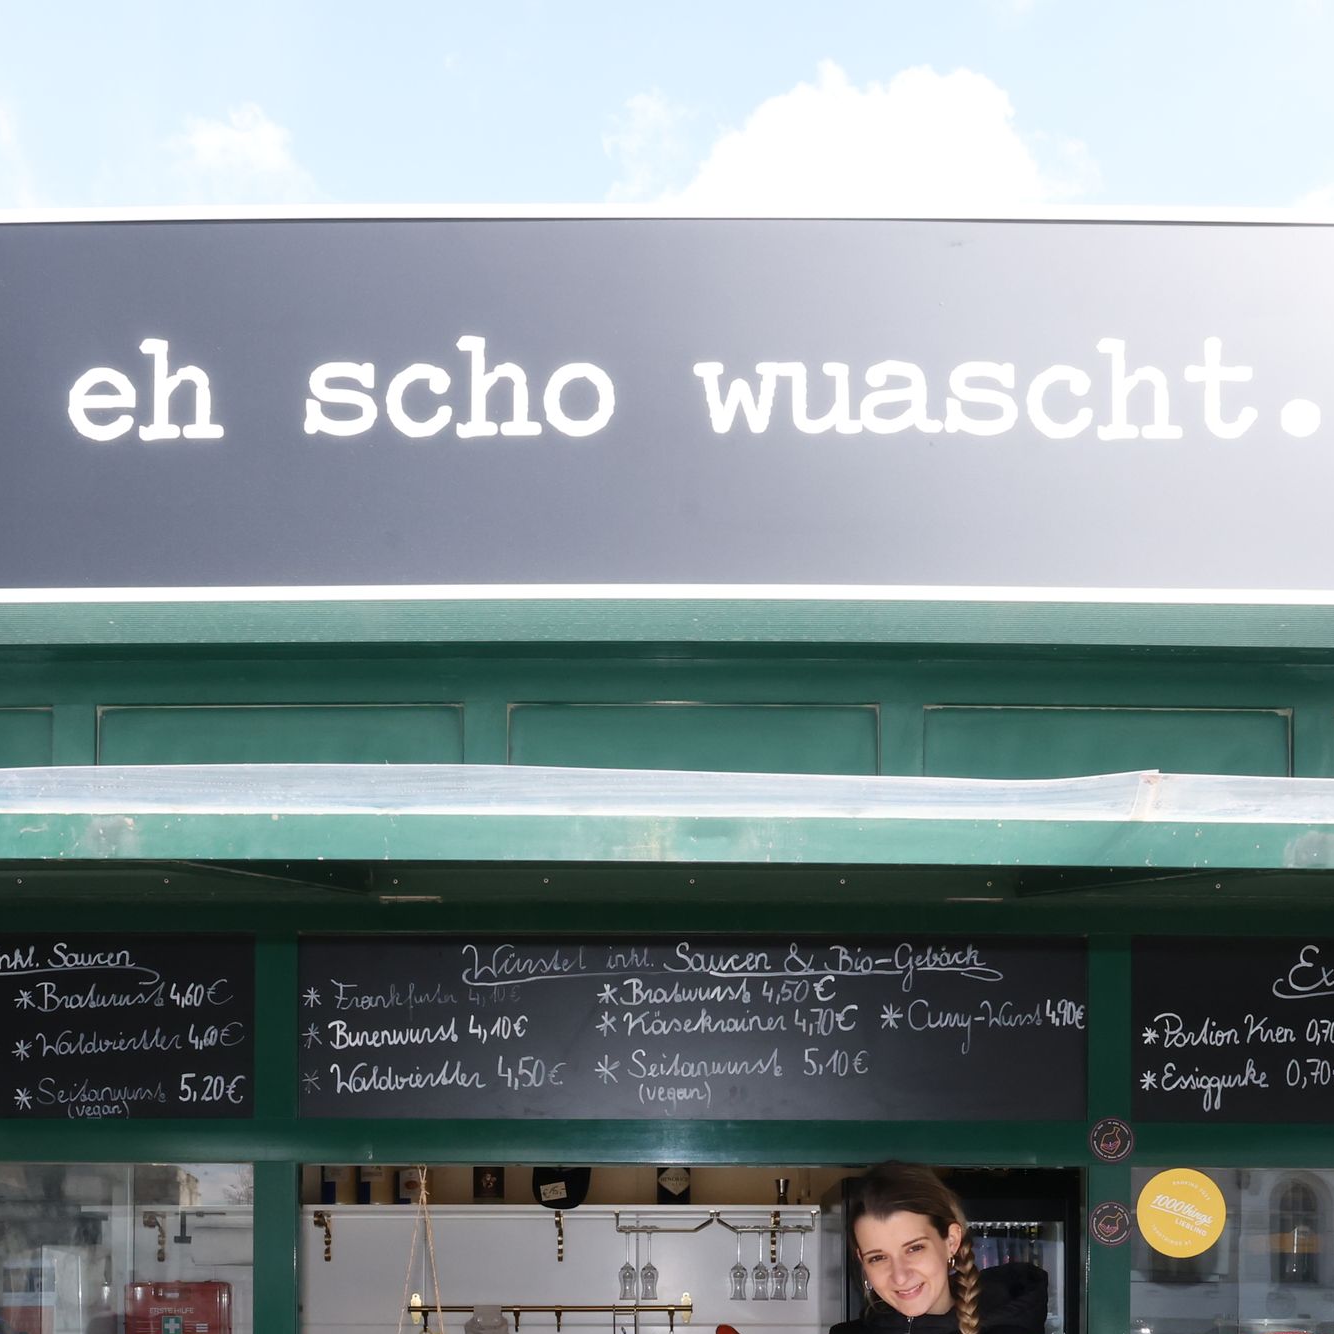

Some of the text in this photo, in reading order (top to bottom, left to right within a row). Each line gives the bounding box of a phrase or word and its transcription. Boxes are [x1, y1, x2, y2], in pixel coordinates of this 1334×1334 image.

[67, 335, 1322, 441] eh scho wuascht.
[47, 943, 135, 968] Saucen
[664, 942, 771, 974] Saucen
[36, 982, 165, 1012] Bratwurst
[620, 978, 751, 1005] Bratwurst
[328, 1017, 459, 1050] Burenwurst
[623, 1008, 787, 1036] Käsekrainer
[1154, 1012, 1240, 1048] Portion
[1244, 1014, 1296, 1047] Kren
[37, 1030, 182, 1058] Waldviertler
[330, 1061, 486, 1094] Waldviertler
[627, 1048, 783, 1078] Seitanwurst
[38, 1080, 167, 1105] Seitanwurst
[1160, 1058, 1269, 1111] Essiggurke
[67, 1101, 130, 1119] (vegan)
